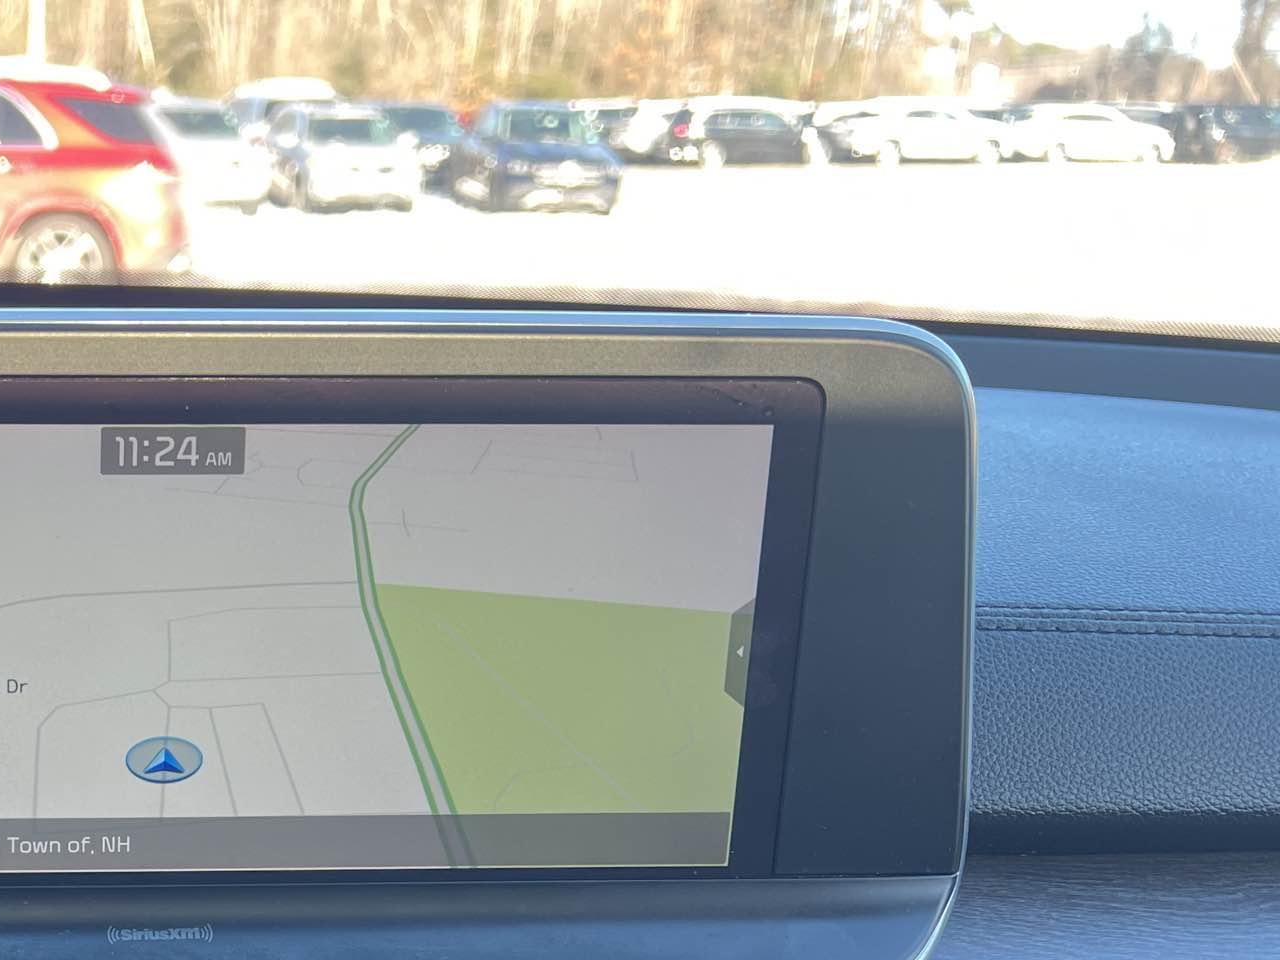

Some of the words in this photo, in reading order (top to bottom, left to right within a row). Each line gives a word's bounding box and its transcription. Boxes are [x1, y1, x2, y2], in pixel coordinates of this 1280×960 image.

[115, 436, 200, 467] 11:24
[205, 451, 232, 467] AM
[7, 679, 28, 694] Dr
[7, 836, 61, 853] Town
[68, 836, 95, 855] of,
[101, 836, 132, 853] NH
